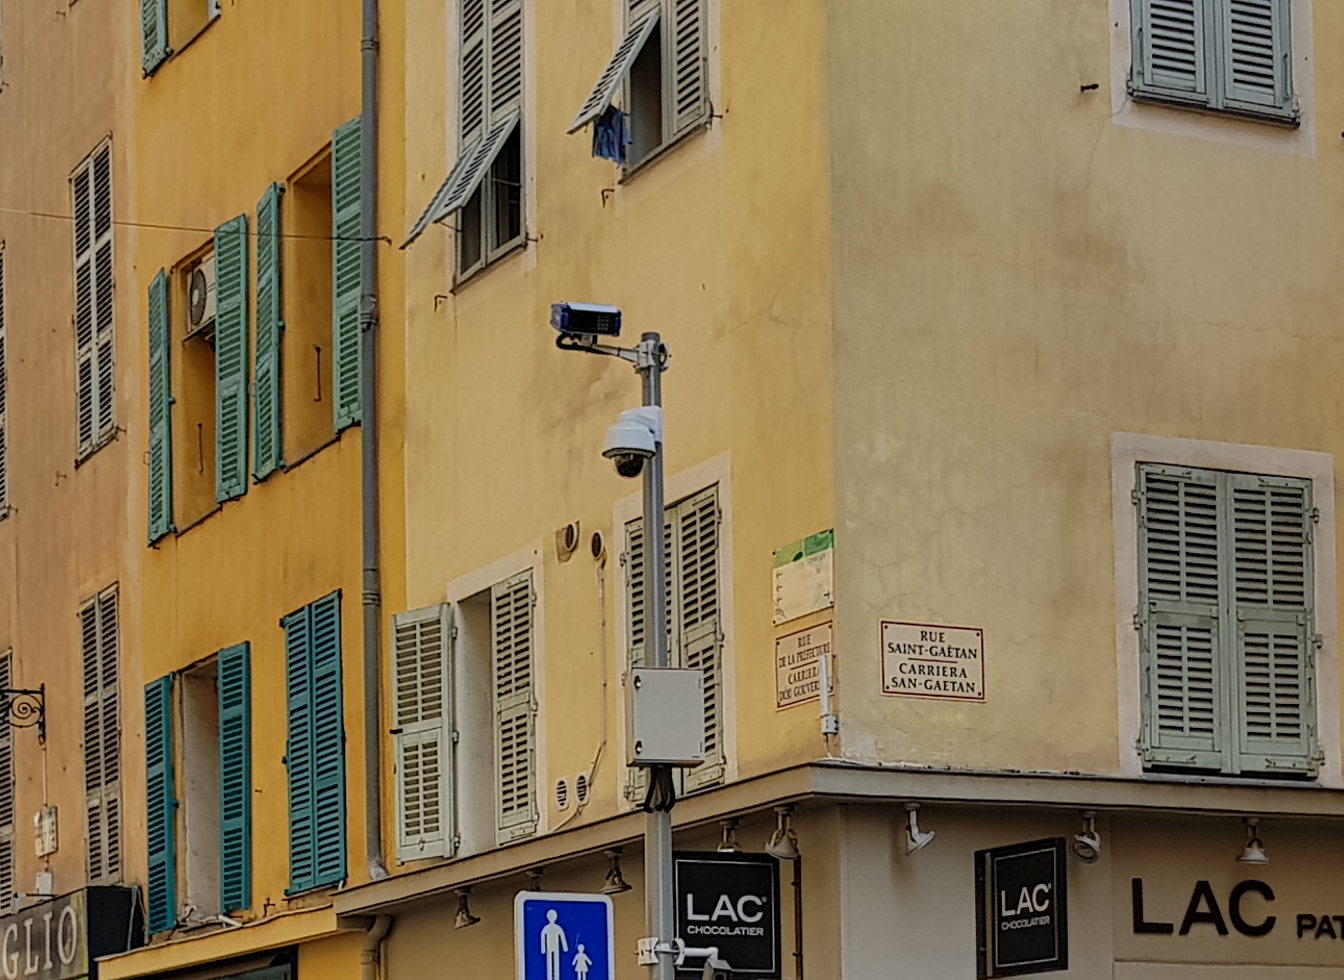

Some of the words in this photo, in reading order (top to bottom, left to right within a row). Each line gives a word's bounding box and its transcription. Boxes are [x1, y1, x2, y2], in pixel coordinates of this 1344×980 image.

[797, 634, 811, 648] RUE
[921, 630, 945, 643] RUE
[888, 642, 977, 659] SAINT-GAÉTAN
[778, 656, 786, 668] DE
[787, 654, 795, 666] LA
[899, 663, 967, 678] CARRIERA
[891, 677, 975, 693] SAN-GAETAN
[687, 893, 764, 922] LAC
[1001, 884, 1050, 916] LAC
[1131, 878, 1276, 937] LAC
[1001, 915, 1050, 930] CHOCOLATIER
[687, 925, 764, 936] CHOCOLATIER
